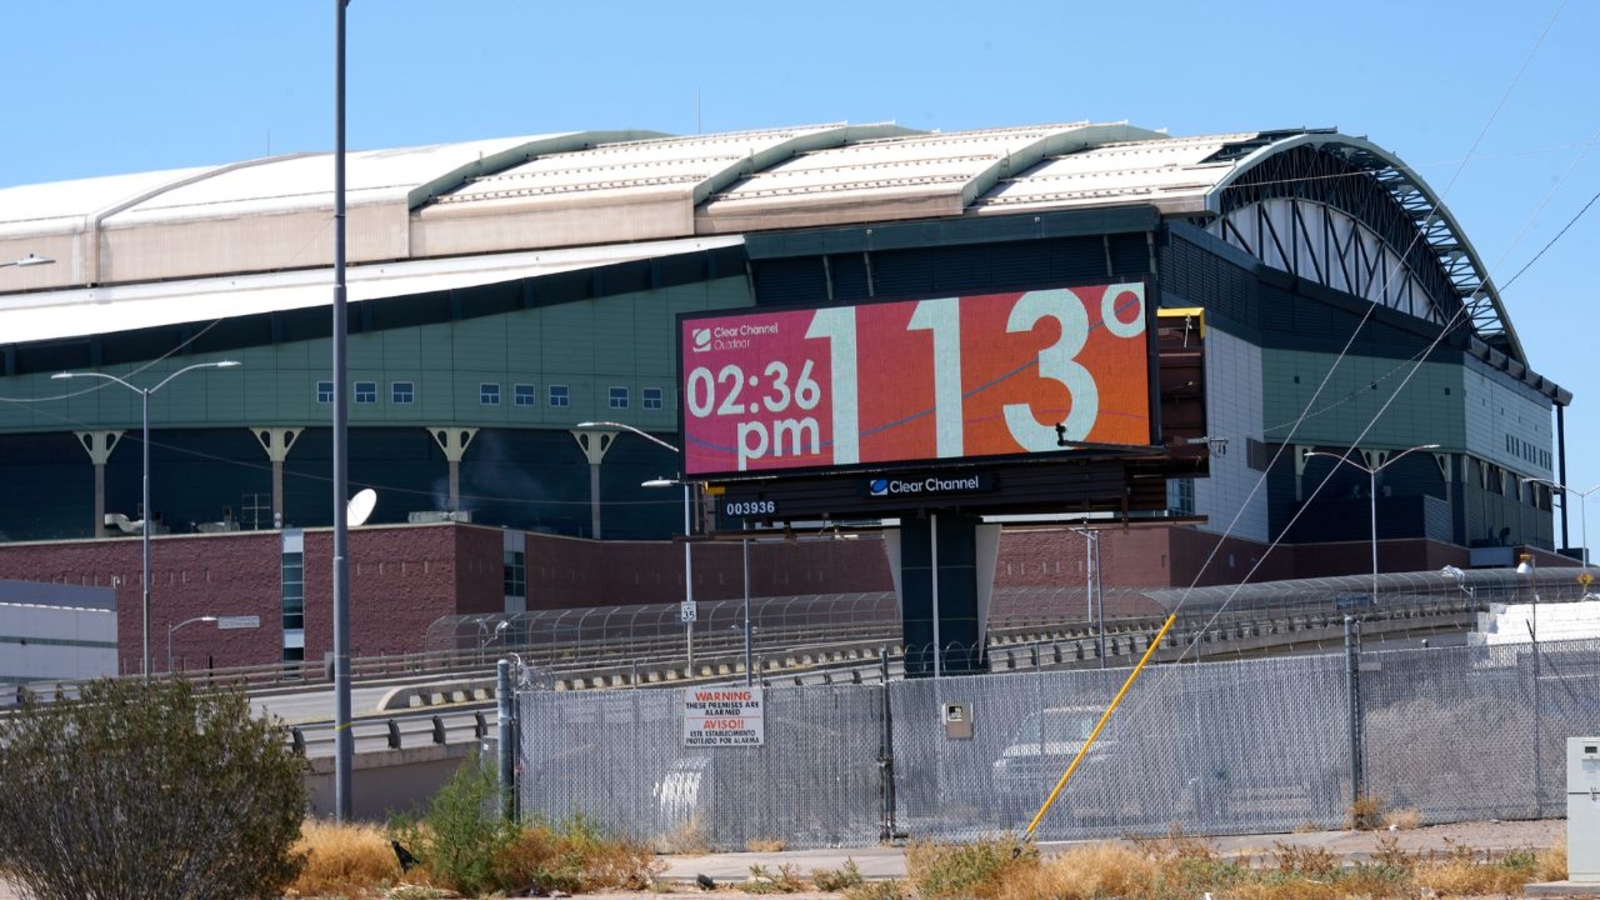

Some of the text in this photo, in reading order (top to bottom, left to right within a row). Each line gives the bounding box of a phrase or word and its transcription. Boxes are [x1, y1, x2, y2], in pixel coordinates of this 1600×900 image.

[714, 323, 779, 338] Clear Channel
[714, 338, 750, 351] Outdoor
[687, 359, 821, 418] 02:36
[737, 417, 820, 472] pm
[889, 476, 979, 493] Clear Channel
[727, 501, 775, 515] 003936
[683, 610, 695, 620] 35
[695, 691, 752, 702] WARNING
[686, 701, 759, 710] THESE PREMISES ARE
[703, 720, 745, 730] AVISO!!
[734, 736, 760, 744] ALARMA
